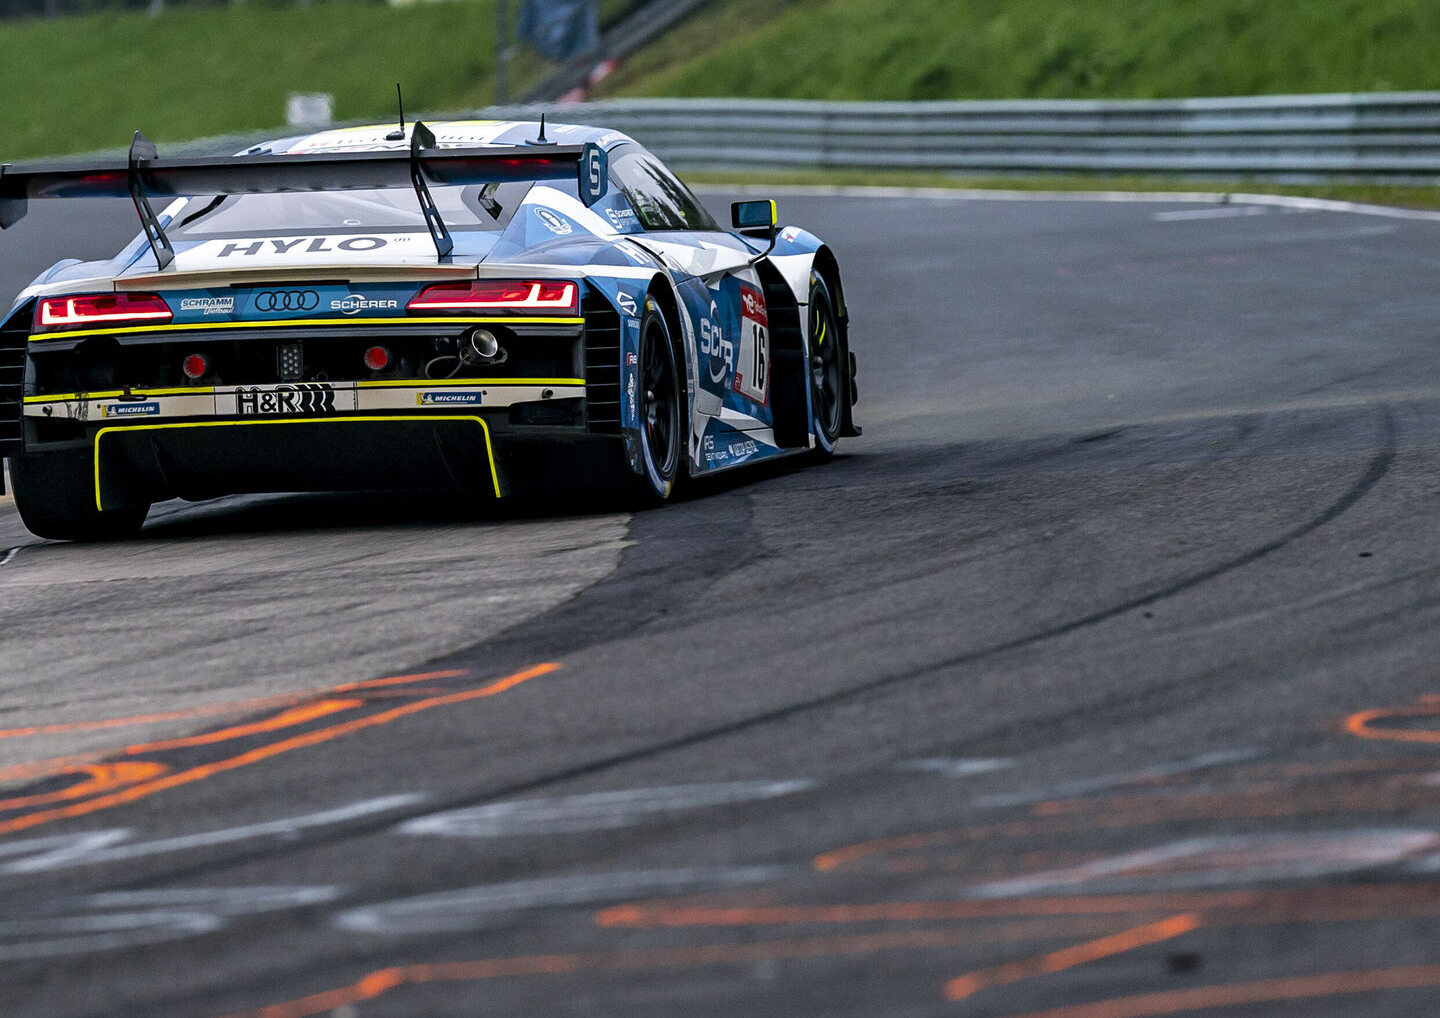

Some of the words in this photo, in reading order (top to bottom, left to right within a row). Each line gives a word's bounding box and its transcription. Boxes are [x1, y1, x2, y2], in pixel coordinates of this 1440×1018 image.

[216, 236, 388, 258] HYLO
[182, 297, 233, 307] SCHRAMM
[330, 299, 398, 309] SCHERER
[752, 324, 766, 391] 16
[236, 385, 297, 415] H&R
